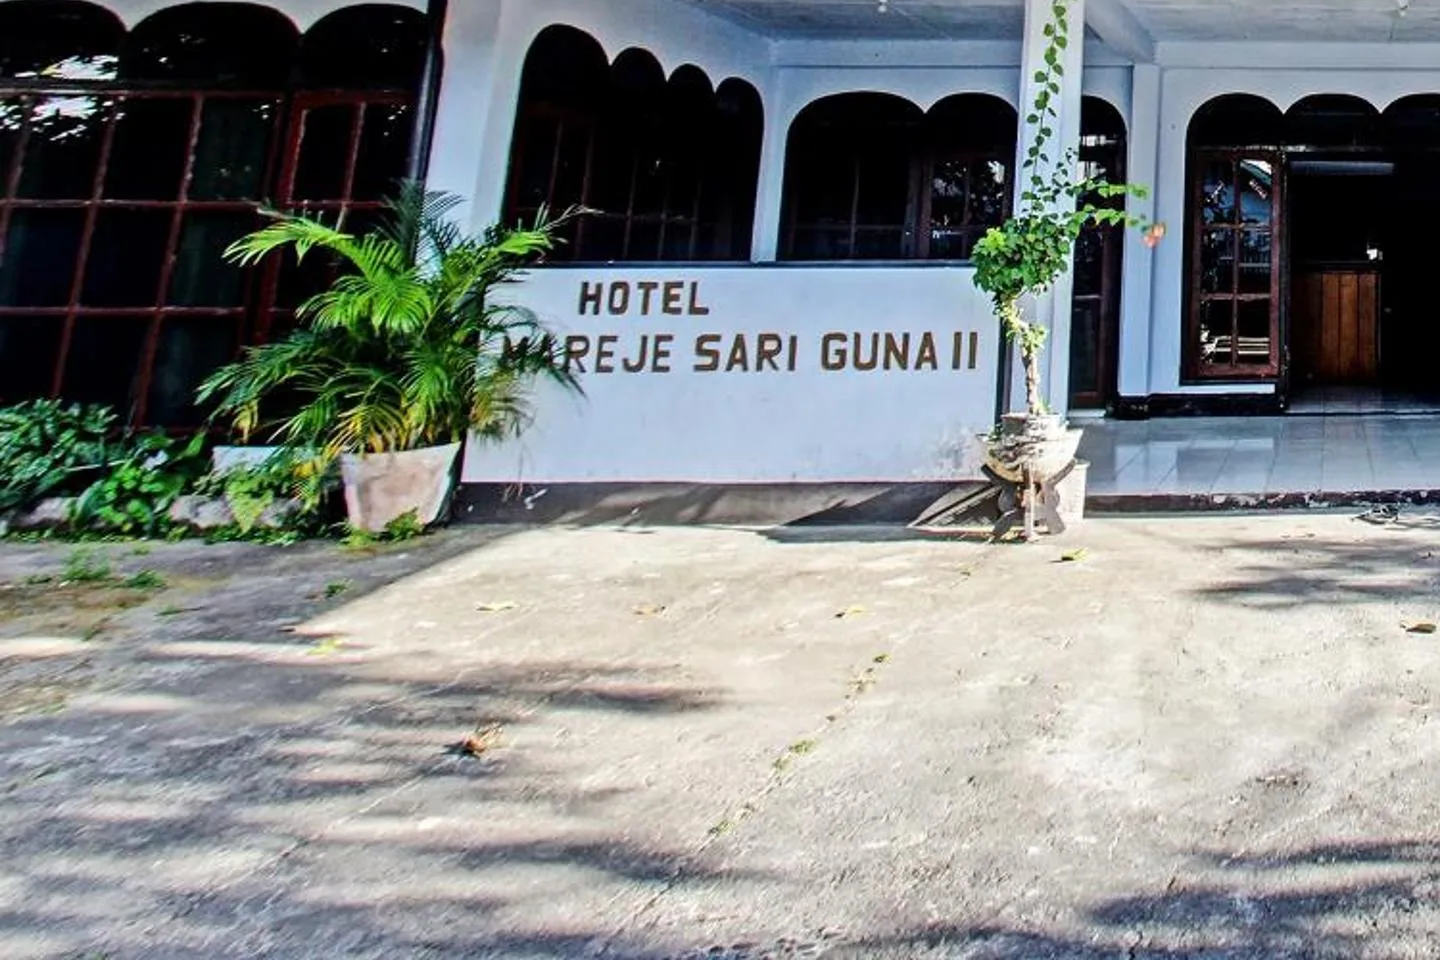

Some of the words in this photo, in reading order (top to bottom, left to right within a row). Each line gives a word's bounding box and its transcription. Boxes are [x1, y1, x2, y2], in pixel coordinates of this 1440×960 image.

[578, 281, 710, 316] HOTEL
[693, 333, 798, 372] SARI
[820, 331, 938, 371] GUNA
[951, 331, 978, 370] II
